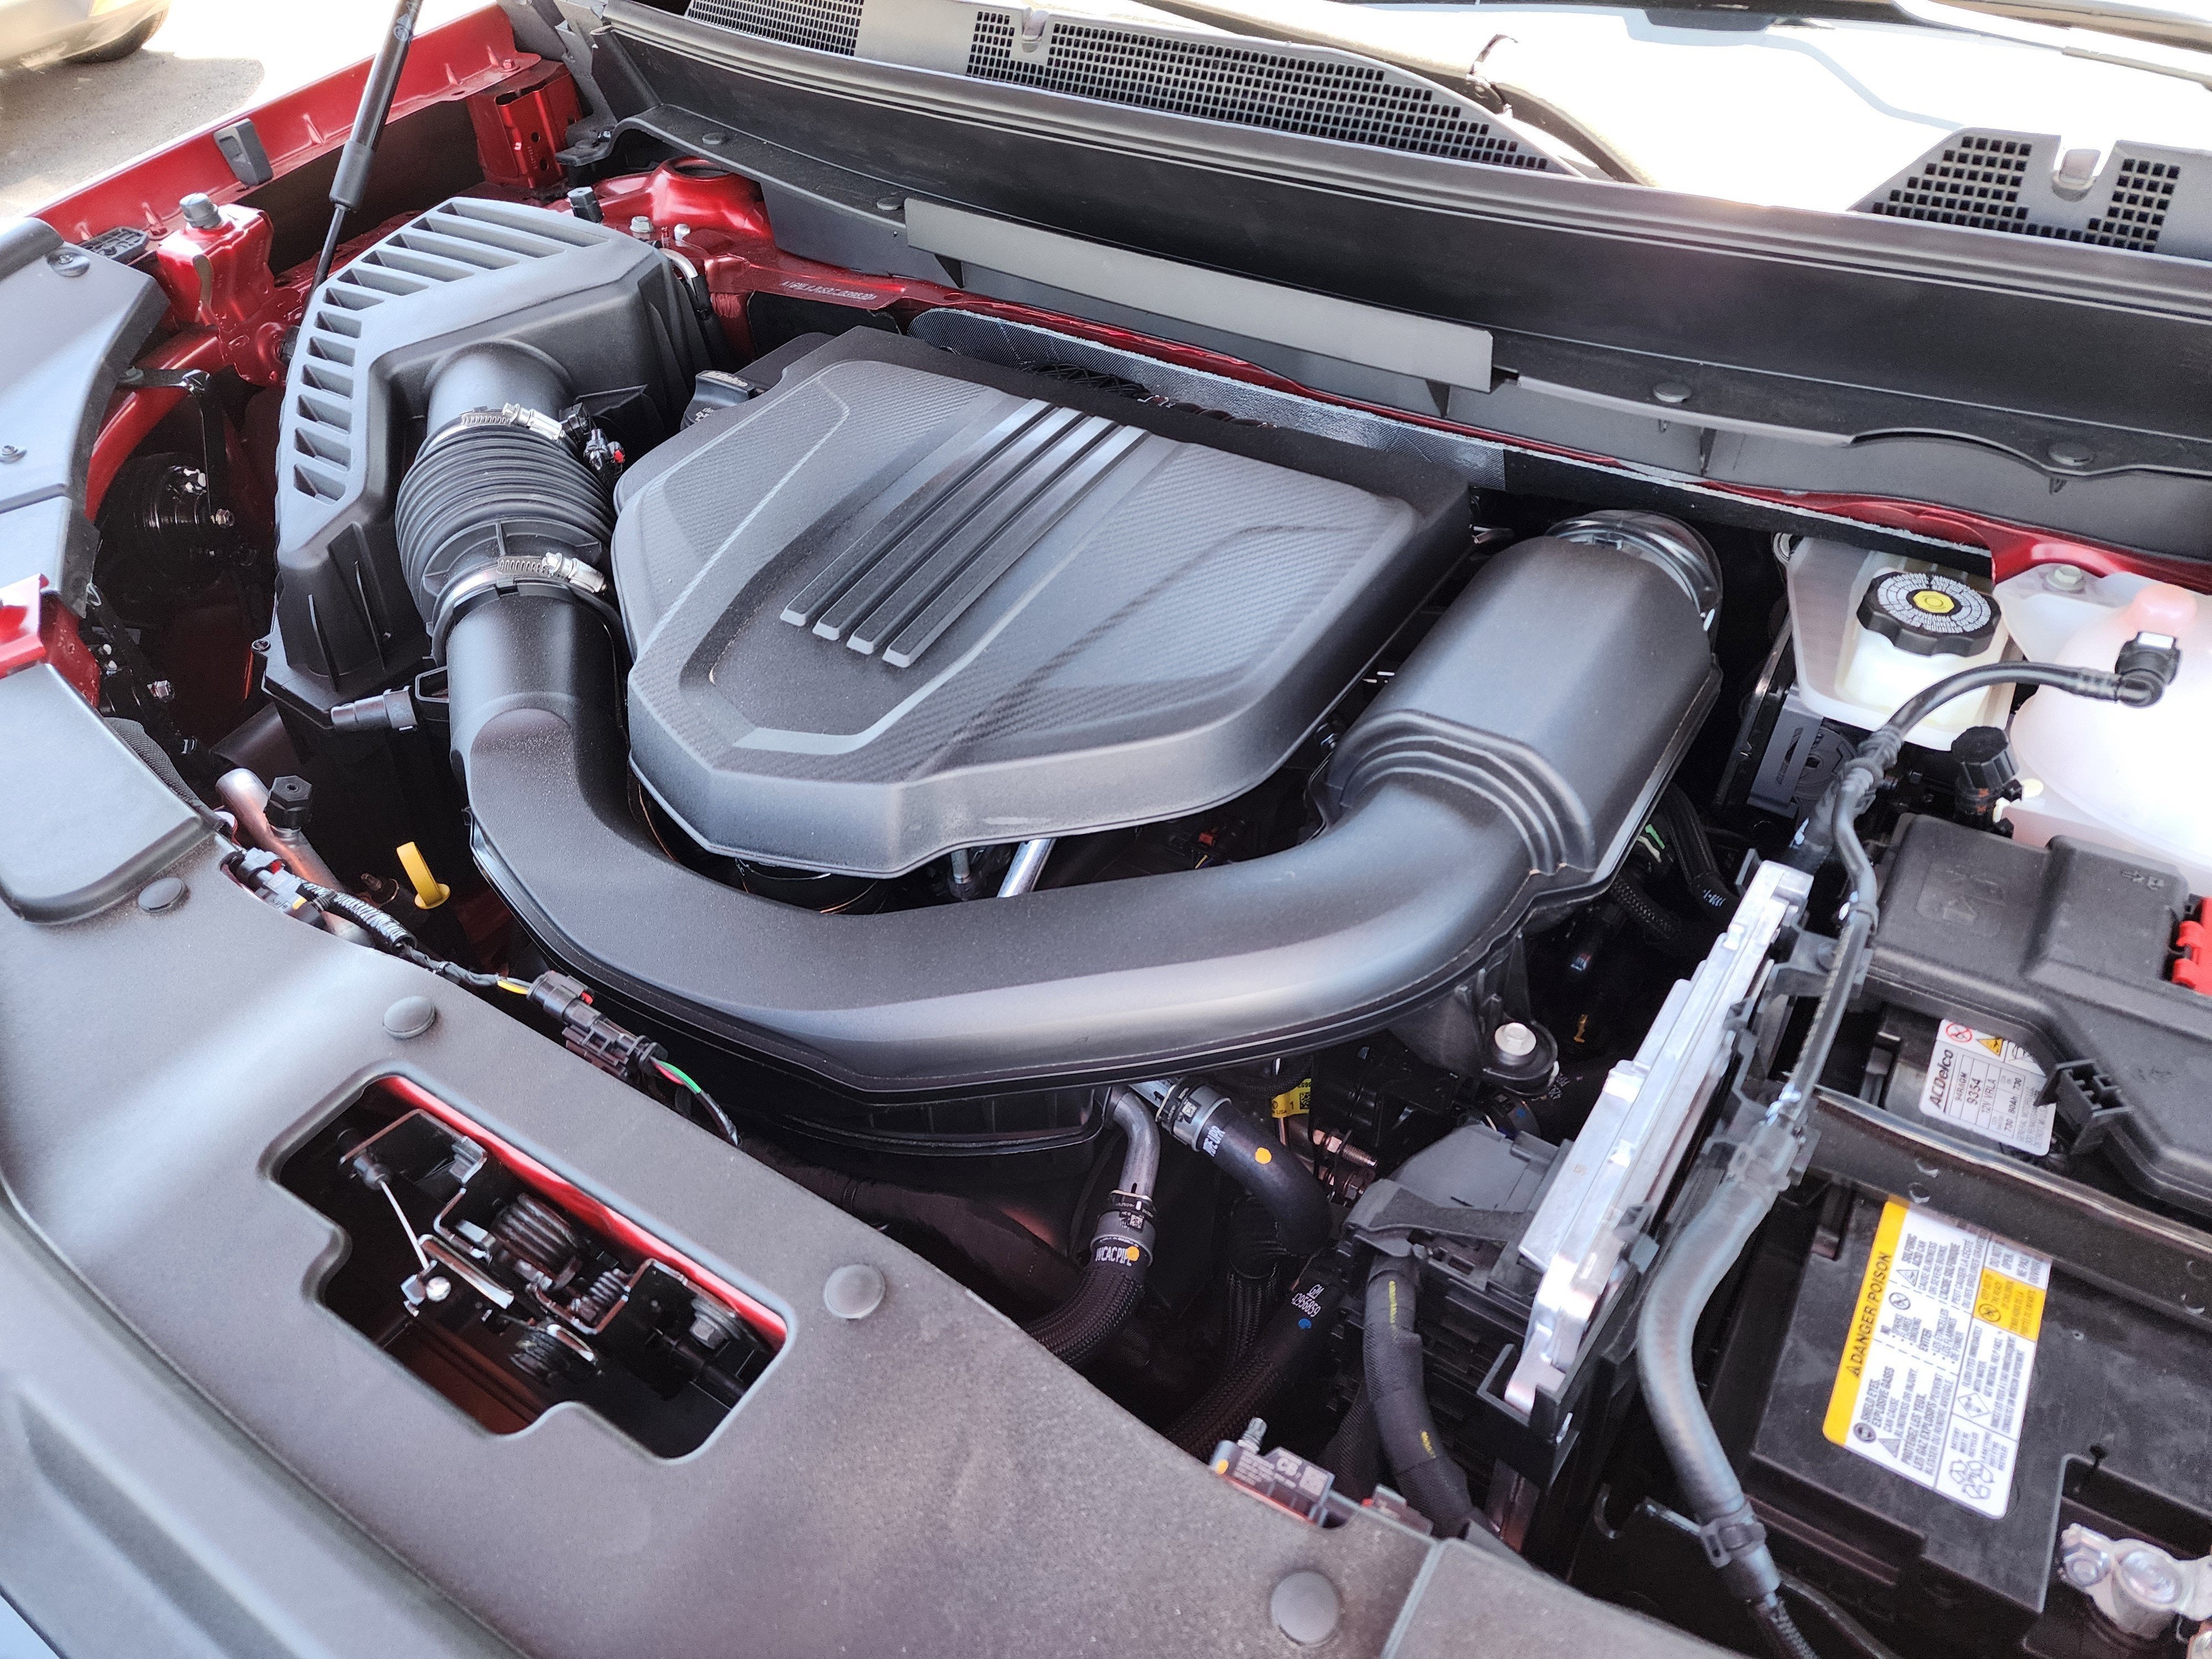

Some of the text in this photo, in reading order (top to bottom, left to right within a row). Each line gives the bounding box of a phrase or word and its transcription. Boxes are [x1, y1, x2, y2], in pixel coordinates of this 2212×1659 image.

[1929, 1049, 1954, 1109] ACDelco
[2013, 1078, 2022, 1089] 730
[1981, 1079, 1996, 1113] 12V VRLA
[1207, 1125, 1226, 1144] UPR
[1309, 1284, 1325, 1298] GM
[1850, 1251, 1891, 1365] DANGER/POISON
[1861, 1397, 1875, 1422] SHIELD
[1871, 1366, 1895, 1427] EXPLOSIVE GASES
[1883, 1397, 1899, 1433] CAN CAUSE
[1894, 1402, 1910, 1438] BLINDNESS
[1902, 1391, 1912, 1402] OR
[1910, 1412, 1922, 1428] LES
[1913, 1373, 1943, 1470] LES GAZ EXPLOSIFS PEUVENT
[1933, 1409, 1947, 1434] RENDRE
[1931, 1434, 1942, 1446] OU
